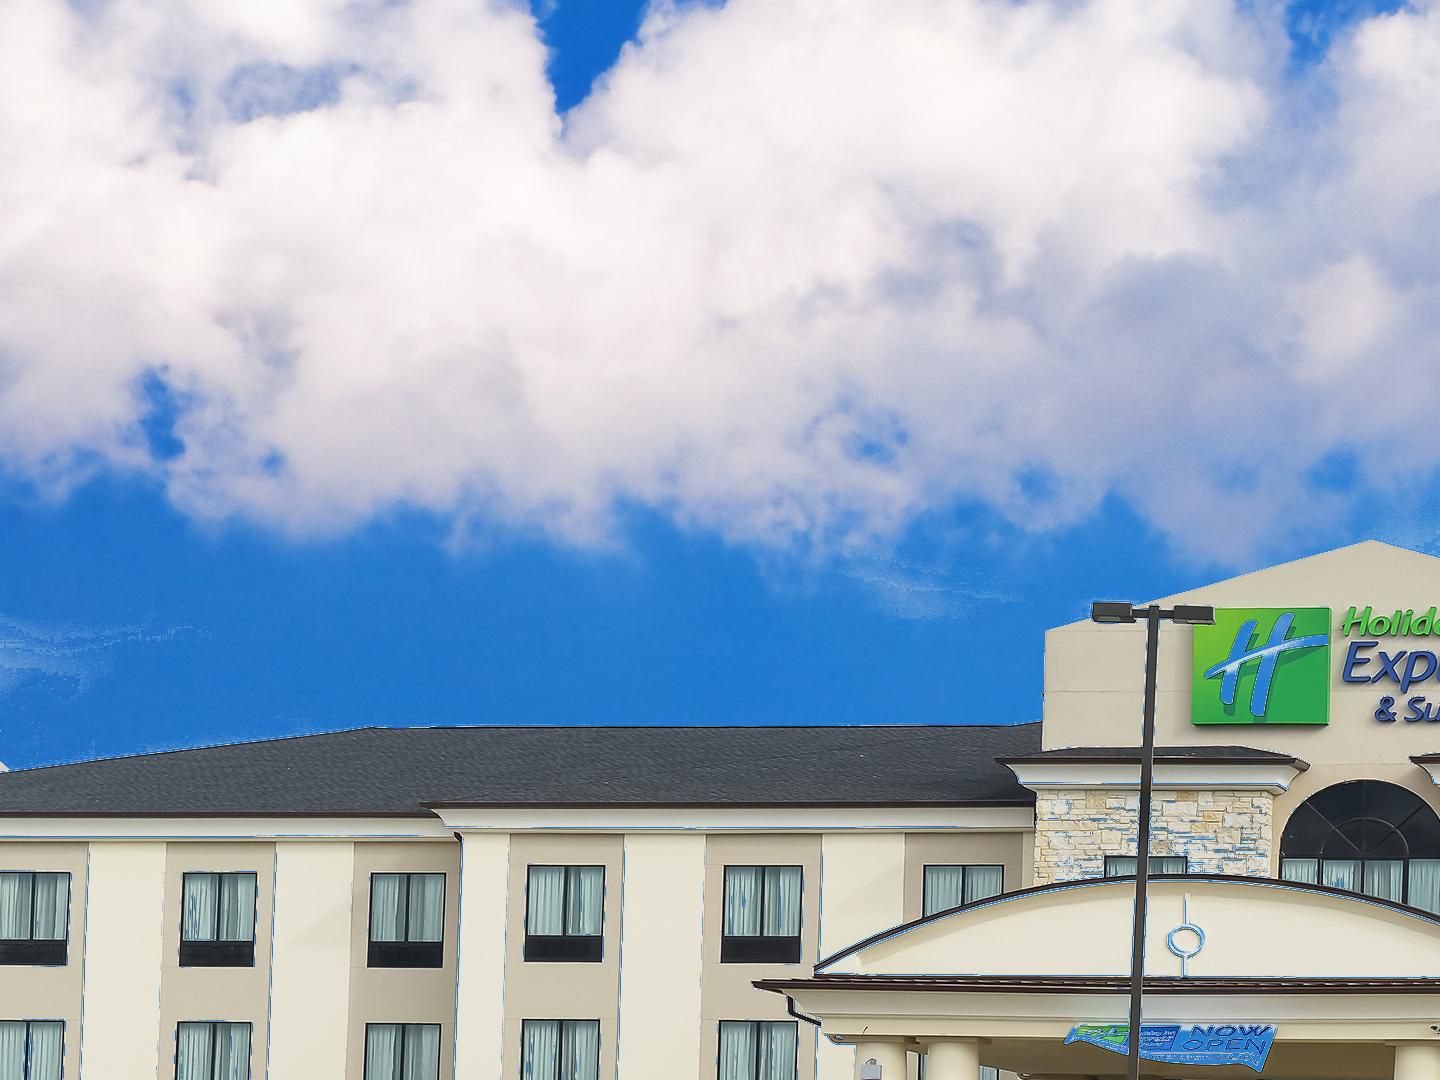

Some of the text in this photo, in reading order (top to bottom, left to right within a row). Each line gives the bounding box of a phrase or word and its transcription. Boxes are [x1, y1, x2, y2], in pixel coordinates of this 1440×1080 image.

[1374, 696, 1398, 723] &
[1189, 1025, 1272, 1038] NOW
[1181, 1038, 1267, 1054] OPEN
